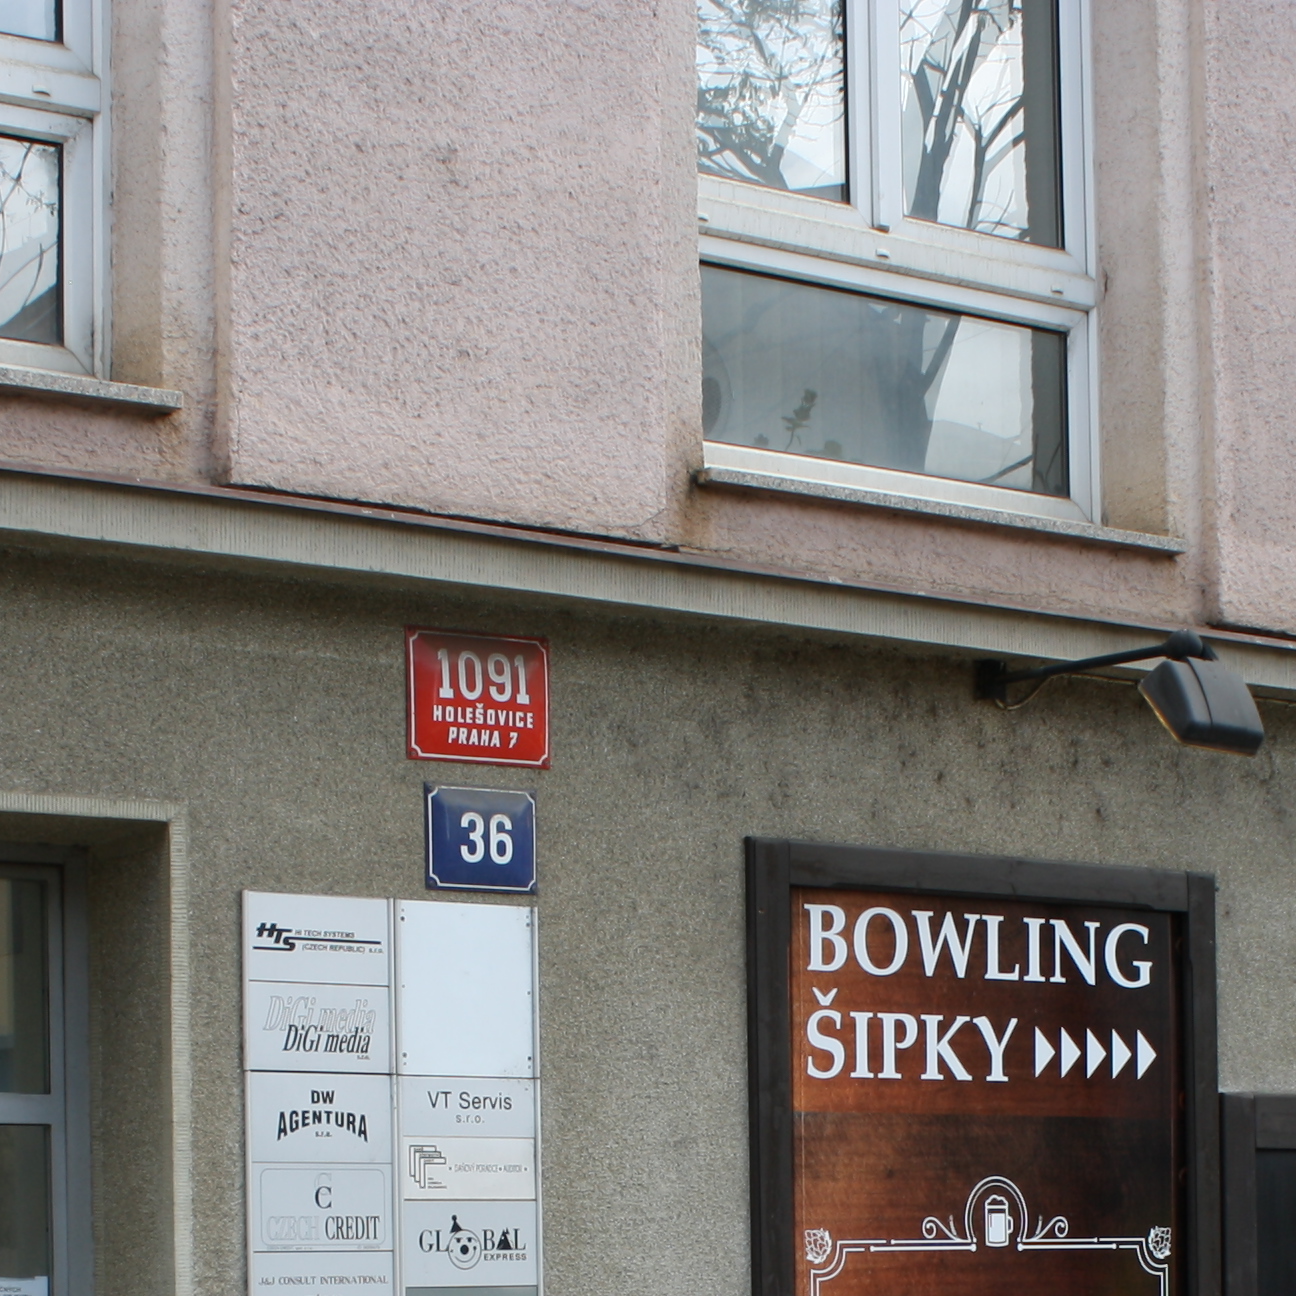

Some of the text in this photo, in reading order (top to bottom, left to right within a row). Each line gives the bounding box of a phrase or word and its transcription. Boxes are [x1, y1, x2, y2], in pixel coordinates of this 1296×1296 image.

[438, 648, 531, 705] 1091
[433, 703, 533, 728] HOLEŠOVICE
[448, 727, 518, 748] PRAHA 7
[460, 811, 513, 864] 36
[804, 903, 1153, 989] BOWLING
[282, 1024, 371, 1054] DiGi media
[806, 986, 1018, 1082] ŠIPKY
[311, 1090, 335, 1104] DW
[427, 1091, 512, 1110] VT Servis
[277, 1110, 368, 1143] AGENTURA
[456, 1114, 485, 1123] s.r.o.
[315, 1186, 332, 1209] C
[267, 1215, 380, 1240] CZECH CREDIT
[278, 1276, 316, 1285] CONSULT
[320, 1275, 388, 1285] INTERNATIONAL
